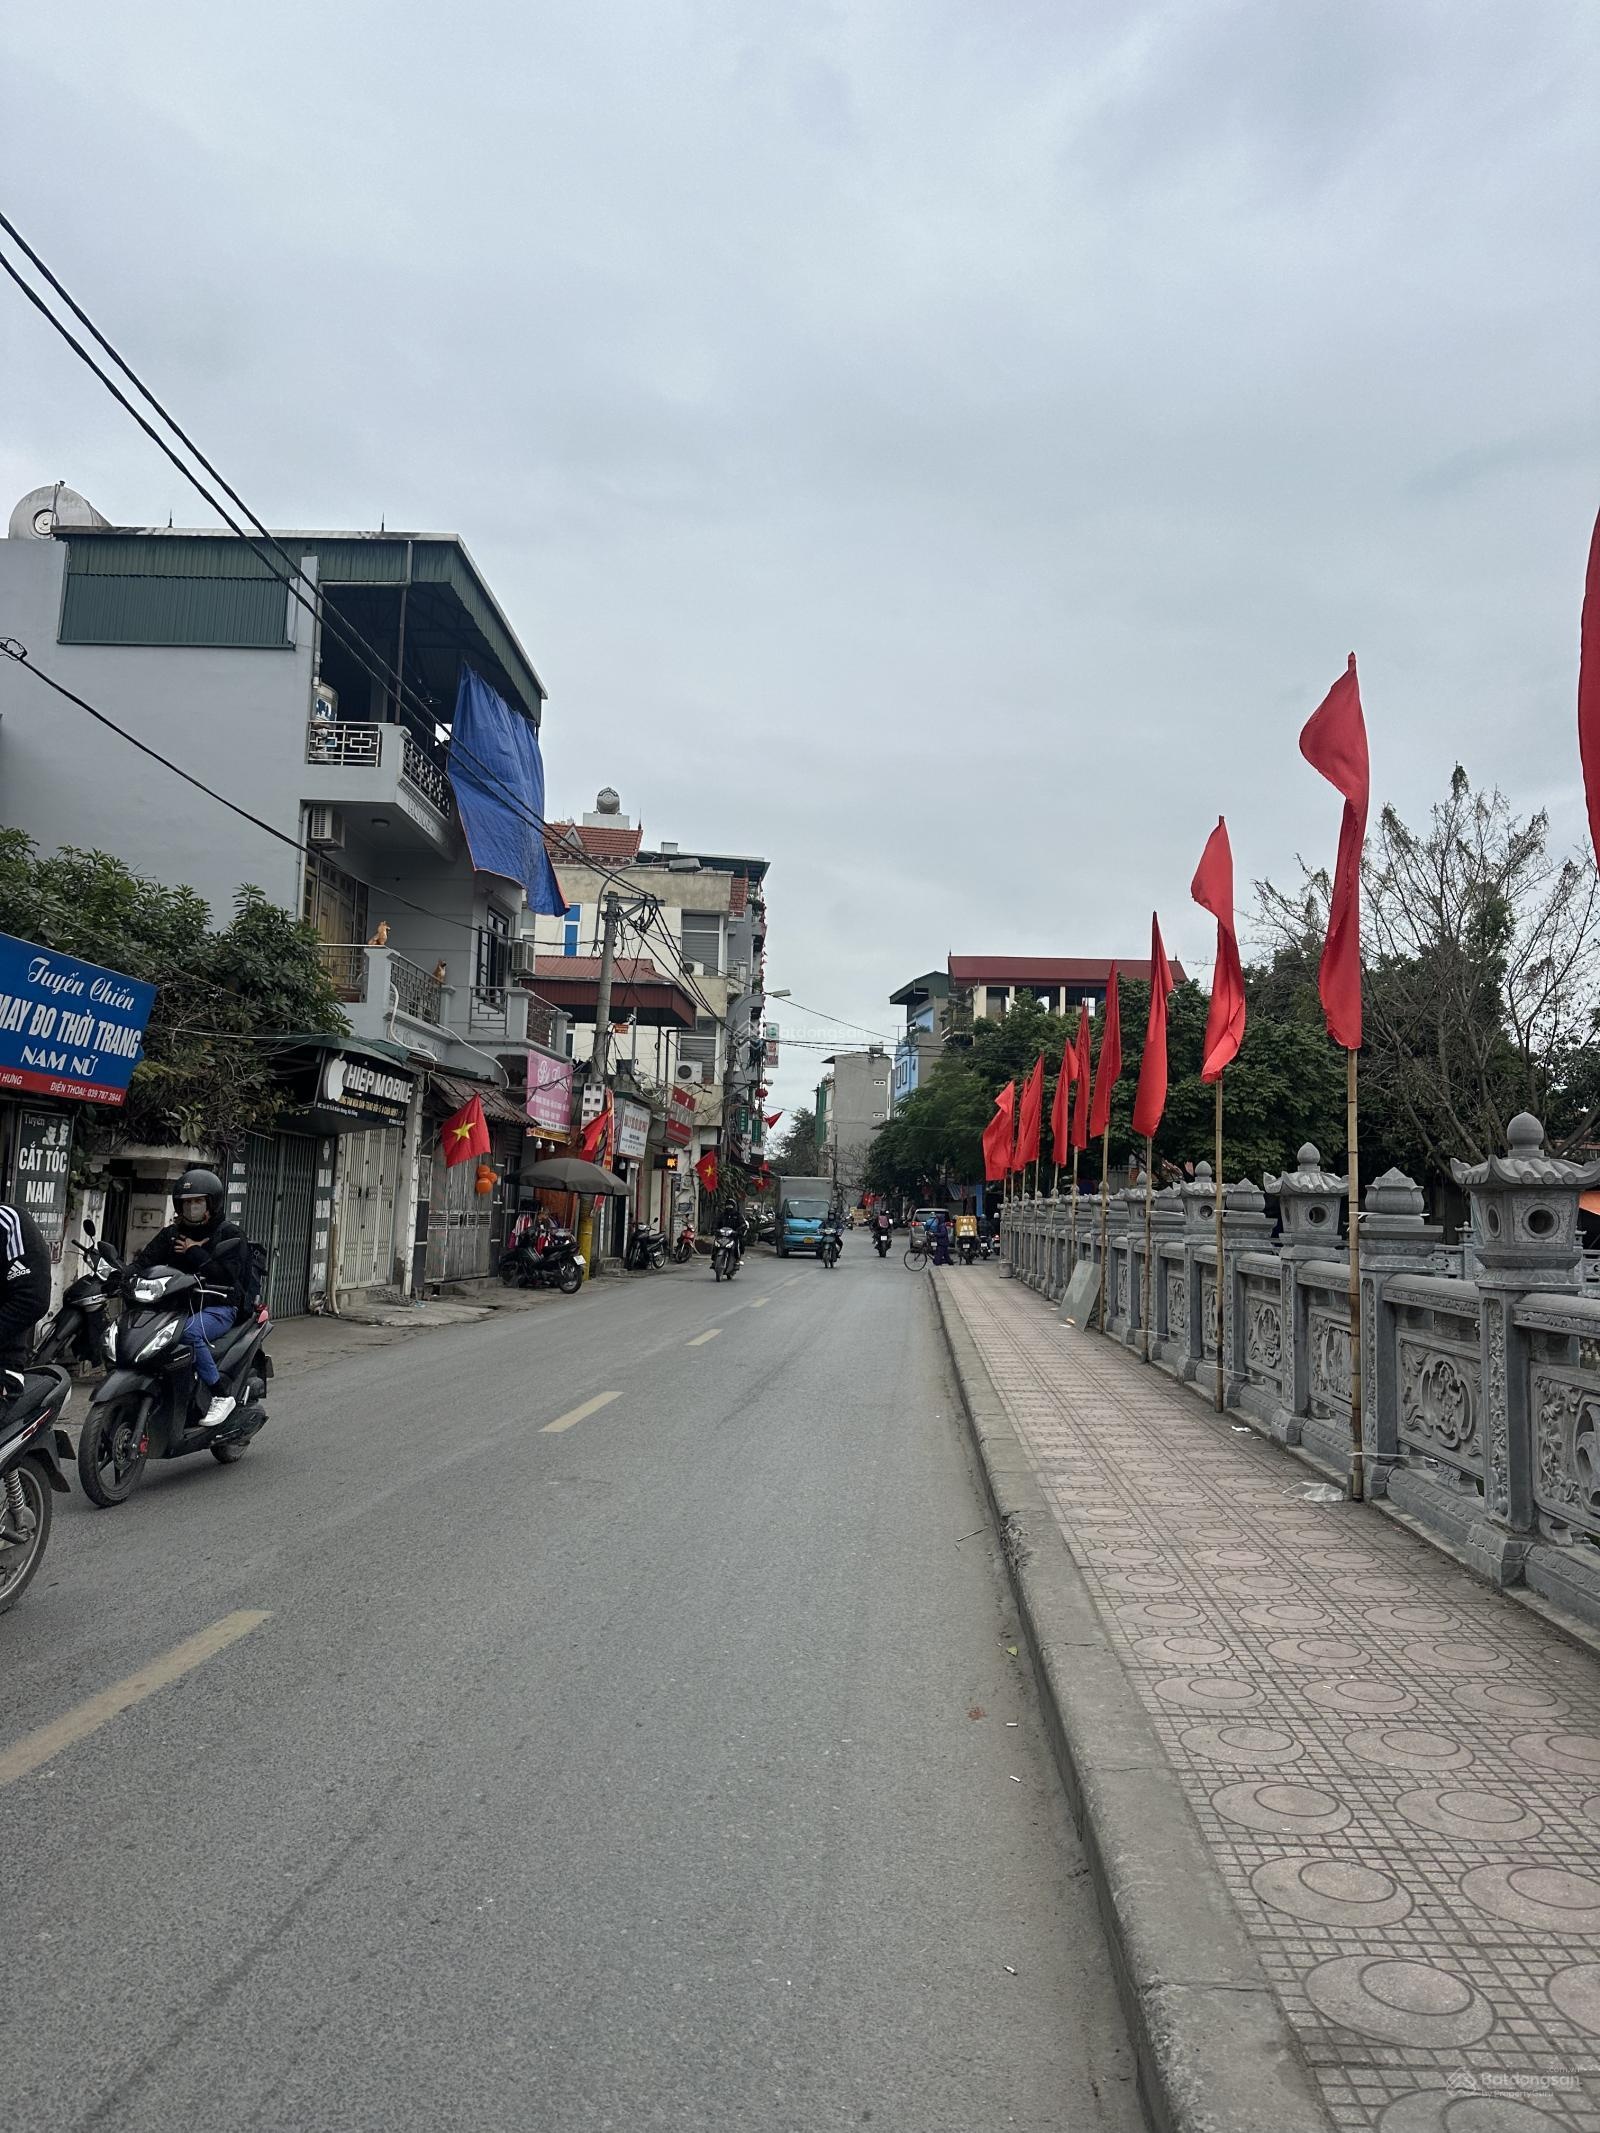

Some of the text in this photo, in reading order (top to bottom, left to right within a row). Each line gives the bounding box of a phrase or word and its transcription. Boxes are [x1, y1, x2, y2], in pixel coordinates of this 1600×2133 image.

[89, 977, 135, 1011] Chiến
[0, 993, 142, 1059] MAY ĐO THỜI TRANG
[20, 1045, 99, 1076] NAM NỮ
[374, 1073, 413, 1104] MOBILE
[19, 1141, 67, 1173] CẮT TÓC
[26, 1181, 55, 1204] NAM
[6, 1268, 31, 1281] adidas
